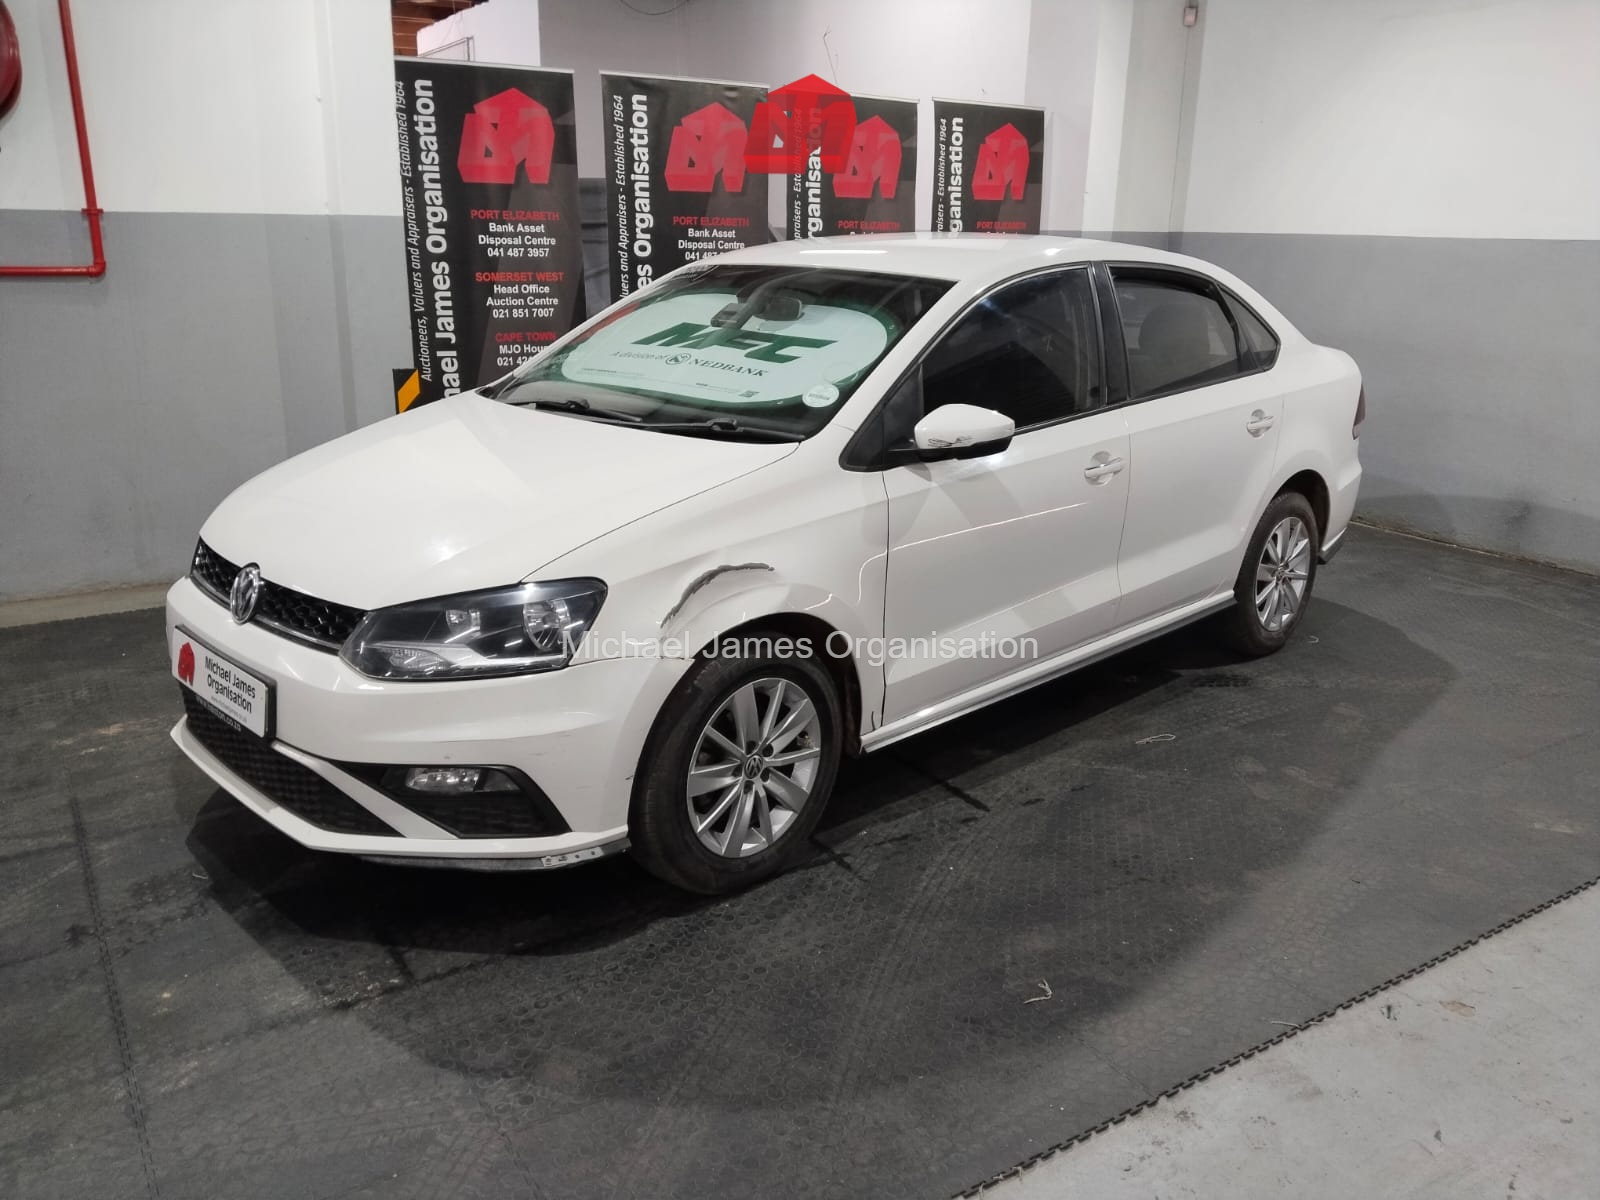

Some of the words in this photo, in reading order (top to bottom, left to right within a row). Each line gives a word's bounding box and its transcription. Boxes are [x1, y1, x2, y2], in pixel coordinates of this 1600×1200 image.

[395, 81, 406, 110] 1964
[613, 94, 624, 122] 1964
[397, 112, 412, 177] Established
[613, 124, 626, 186] Established
[413, 79, 448, 254] Organisation
[629, 94, 654, 257] Organisation
[937, 143, 946, 197] Established
[404, 186, 420, 246] Appraisers
[470, 209, 500, 220] PORT
[502, 210, 560, 221] ELIZABETH
[616, 194, 629, 250] Appraisers
[672, 216, 698, 226] PORT
[488, 222, 515, 232] Bank
[516, 223, 545, 233] Asset
[687, 228, 710, 238] Bank
[711, 228, 736, 238] Asset
[478, 234, 522, 246] Disposal
[524, 235, 556, 245] Centre
[678, 239, 716, 250] Disposal
[717, 240, 745, 250] Centre
[408, 246, 422, 270] and
[487, 247, 504, 257] 041
[506, 247, 525, 257] 487
[527, 248, 550, 257] 3957
[617, 250, 629, 272] and
[684, 251, 700, 260] 041
[475, 272, 533, 282] SOMERSET
[535, 271, 564, 281] WEST
[619, 273, 629, 298] luers
[412, 272, 425, 312] Valuers
[493, 284, 519, 294] Head
[521, 284, 550, 294] Office
[431, 261, 456, 344] James
[486, 296, 524, 307] Auction
[526, 296, 559, 305] Centre
[492, 308, 509, 318] 021
[512, 308, 529, 318] 851
[532, 308, 554, 317] 7007
[495, 332, 523, 343] CAPE
[526, 331, 556, 341] TOWN
[630, 321, 838, 364] MFC
[417, 316, 432, 382] Auctioneers,
[499, 344, 521, 354] MJO
[496, 357, 513, 366] 021
[689, 358, 767, 377] NEDBANK
[205, 656, 231, 684] Michael
[232, 674, 256, 699] James
[207, 674, 252, 714] Organisation
